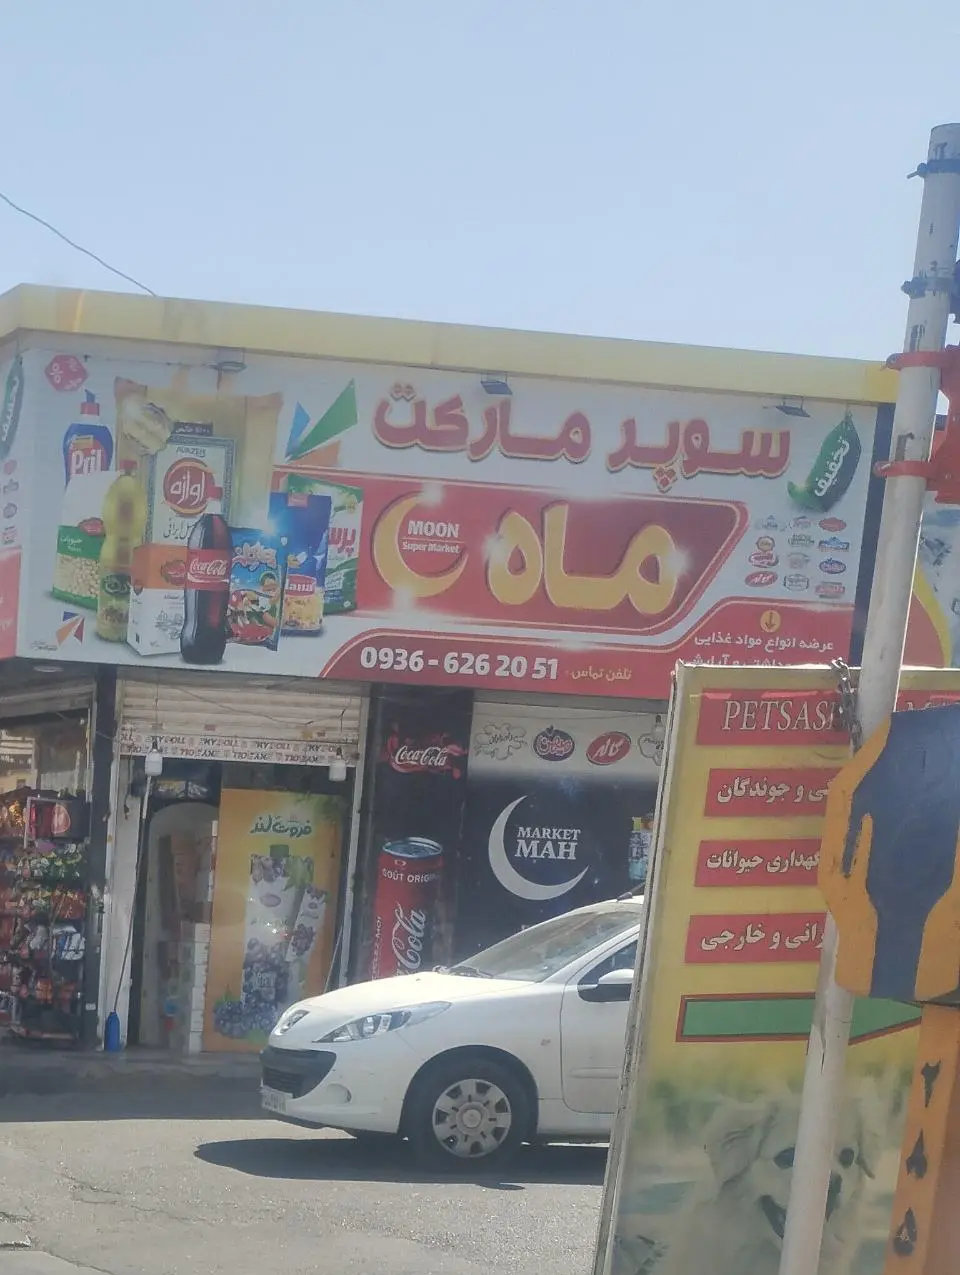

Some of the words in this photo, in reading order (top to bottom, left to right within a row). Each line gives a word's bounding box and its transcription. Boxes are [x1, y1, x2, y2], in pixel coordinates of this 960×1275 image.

[372, 382, 592, 463] مارکت
[70, 448, 102, 475] Pril
[607, 413, 792, 493] سوپر
[407, 520, 460, 538] MOON
[487, 500, 679, 616] ماه
[694, 631, 732, 646] غذایی
[735, 634, 762, 648] مواد
[764, 638, 796, 652] انواع
[799, 639, 834, 652] عرضه
[360, 646, 424, 672] 0936
[443, 652, 490, 675] 626
[495, 656, 528, 678] 20
[532, 657, 558, 680] 51
[571, 667, 604, 681] تماس
[606, 668, 632, 682] تلفن
[717, 776, 790, 803] جوندگان
[793, 784, 805, 803] و
[517, 826, 582, 841] MARKET
[514, 839, 578, 860] MAH
[706, 848, 764, 874] حیوانات
[700, 922, 766, 951] خارجی
[769, 930, 781, 949] و
